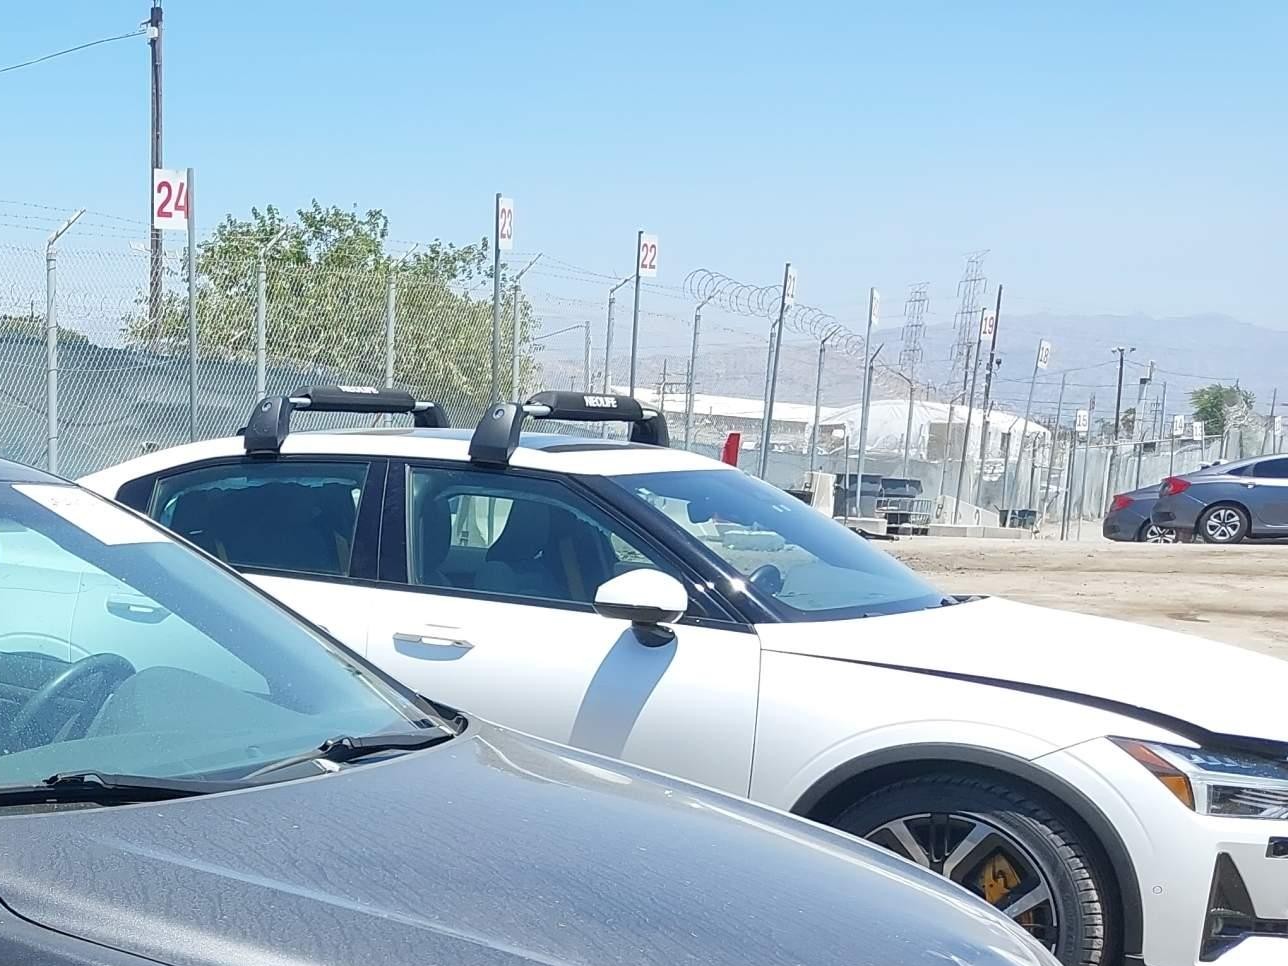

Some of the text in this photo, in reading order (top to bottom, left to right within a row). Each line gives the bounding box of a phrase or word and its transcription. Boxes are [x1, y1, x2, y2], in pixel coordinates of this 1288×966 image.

[157, 180, 189, 219] 24
[500, 207, 513, 240] 23
[641, 243, 657, 270] 22
[982, 316, 995, 335] 19
[583, 395, 618, 408] NEOLIFE
[1077, 414, 1088, 427] 15
